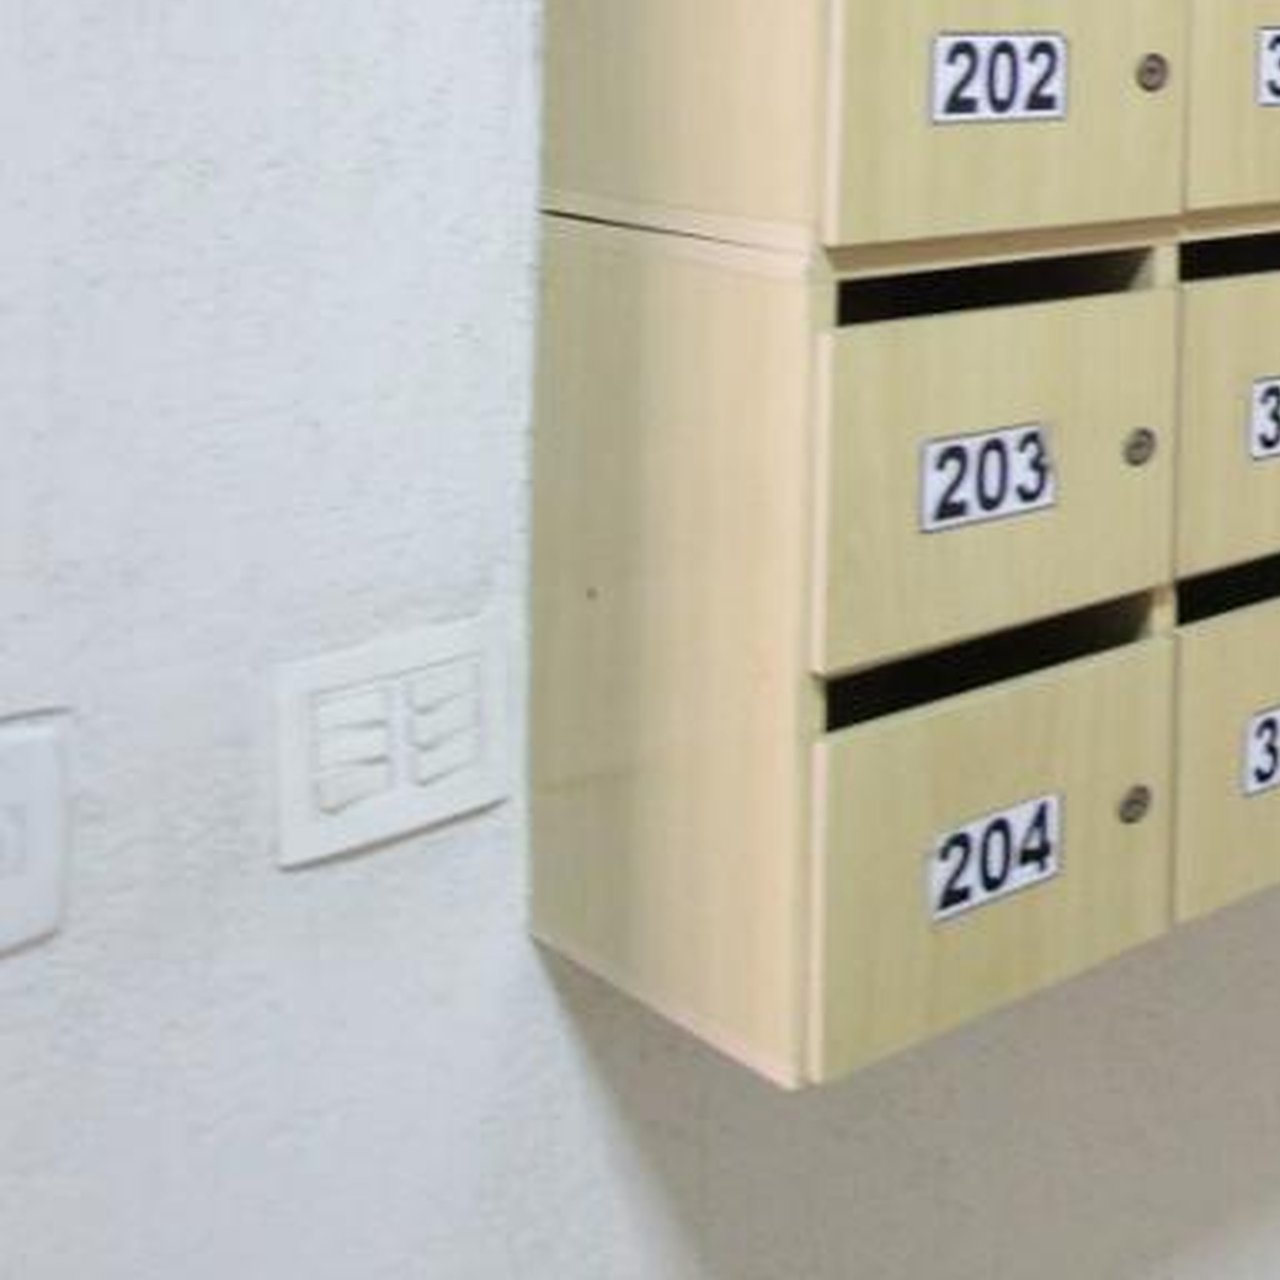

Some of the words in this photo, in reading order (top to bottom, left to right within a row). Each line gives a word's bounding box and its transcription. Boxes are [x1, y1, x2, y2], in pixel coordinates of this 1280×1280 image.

[944, 40, 1059, 114] 202
[934, 430, 1048, 520] 203
[937, 800, 1051, 910] 204
